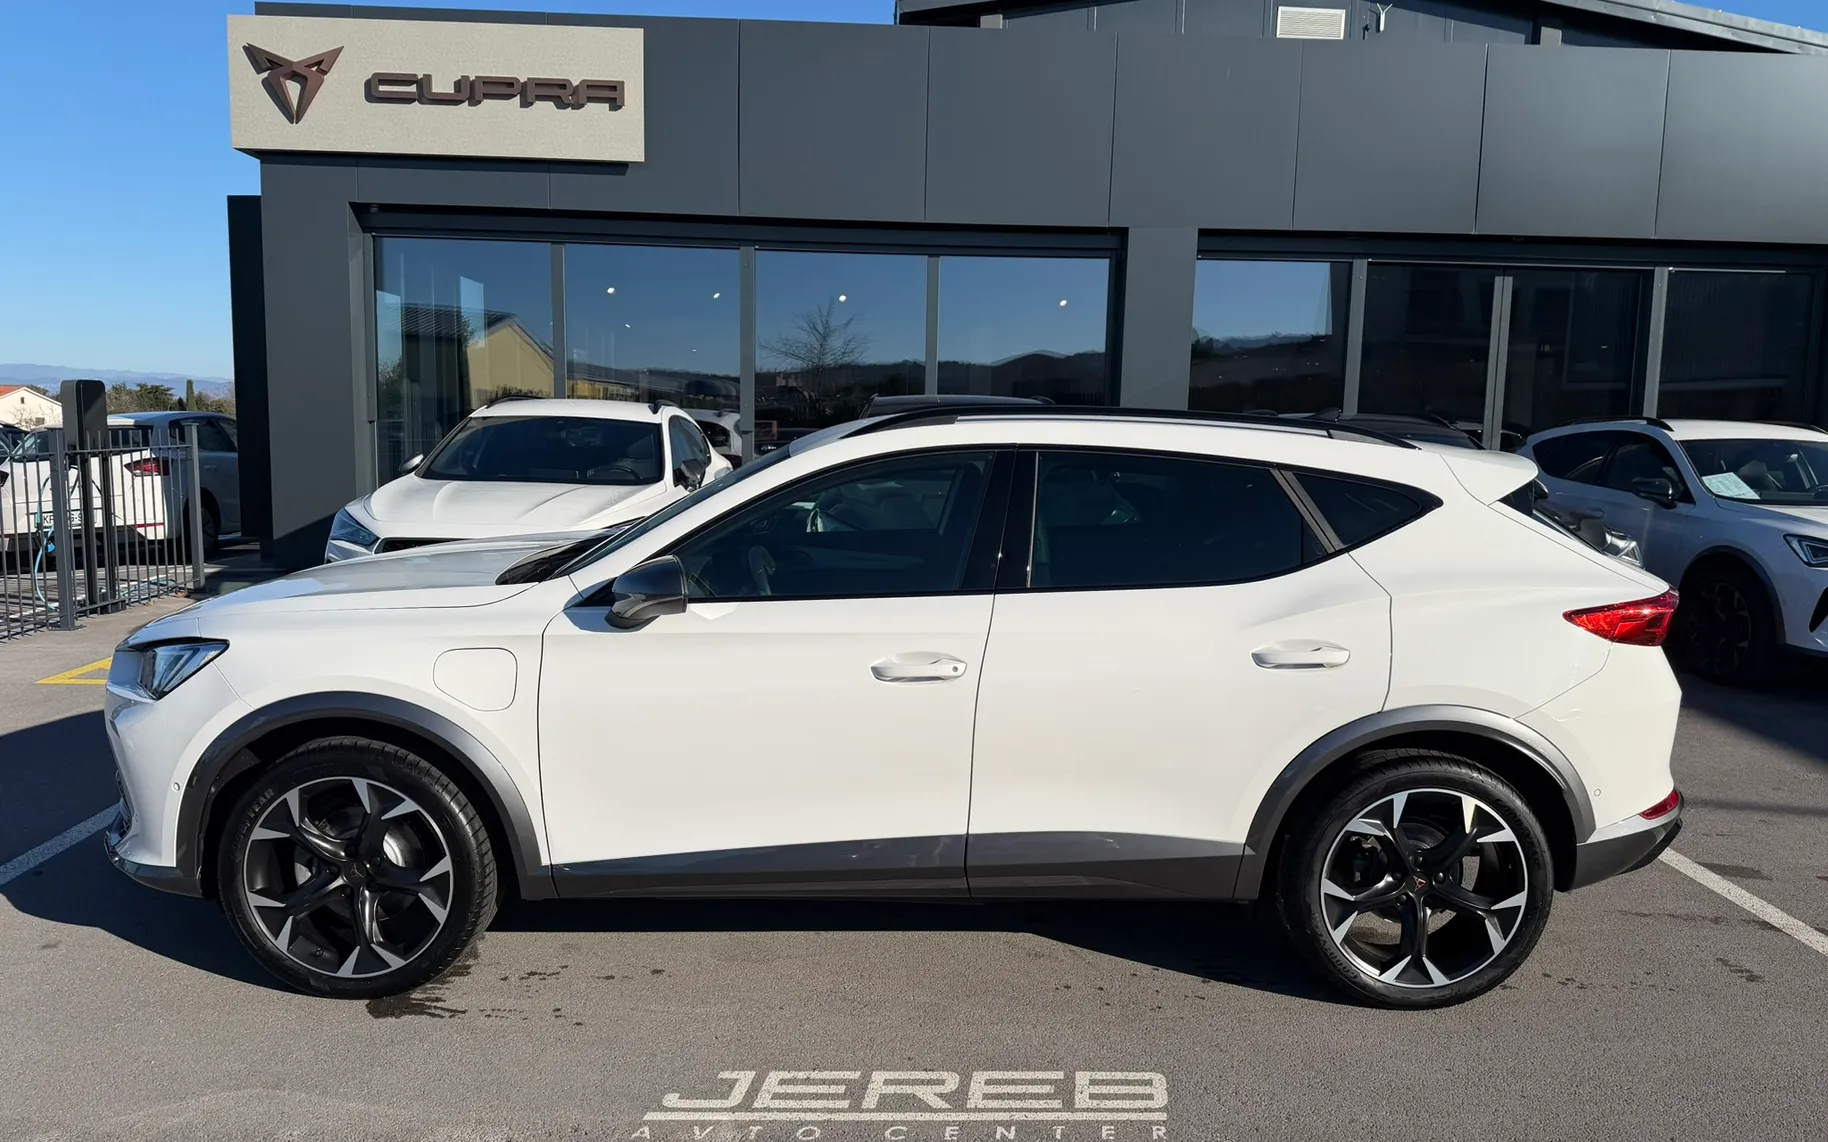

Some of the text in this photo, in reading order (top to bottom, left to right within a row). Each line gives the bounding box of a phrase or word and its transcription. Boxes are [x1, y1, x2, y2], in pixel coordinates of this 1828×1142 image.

[368, 72, 625, 110] CUPRA
[662, 1070, 1168, 1109] JEREB
[630, 1125, 1167, 1141] AVTO CENTER
